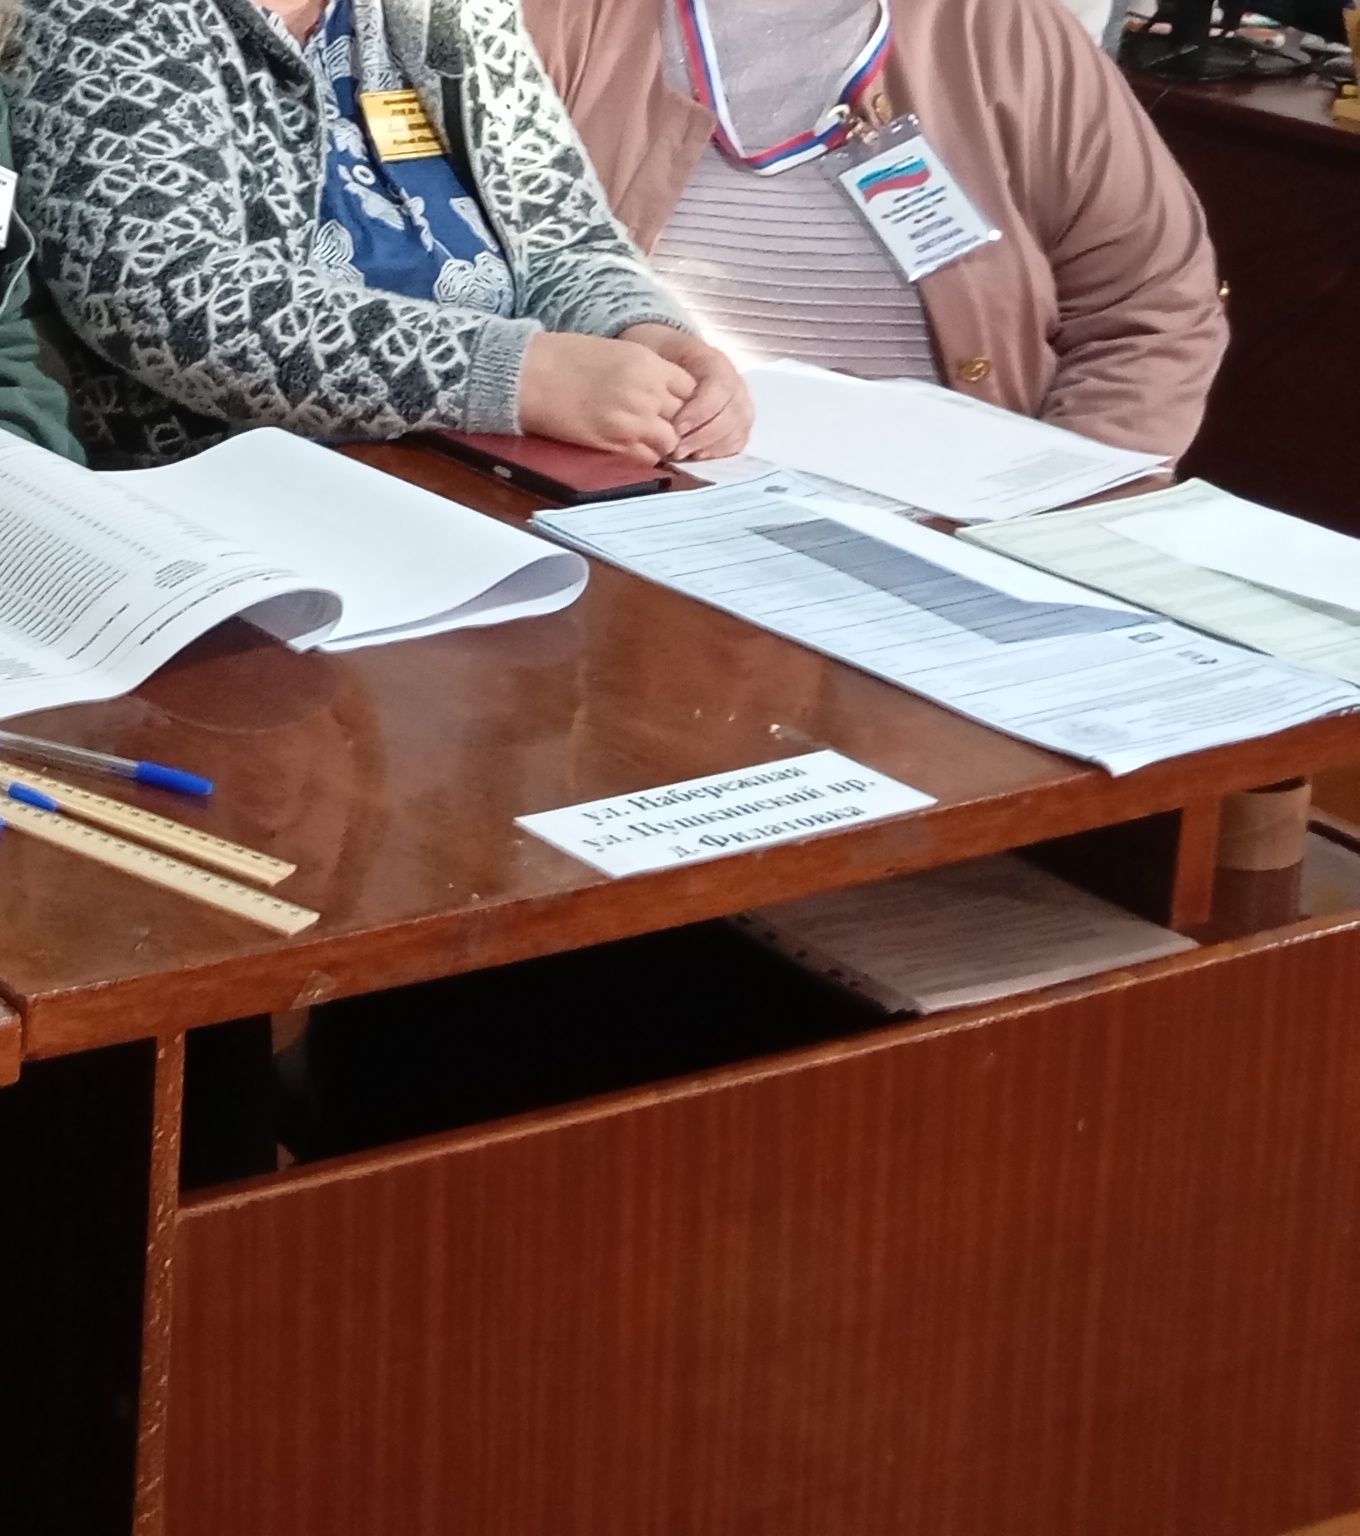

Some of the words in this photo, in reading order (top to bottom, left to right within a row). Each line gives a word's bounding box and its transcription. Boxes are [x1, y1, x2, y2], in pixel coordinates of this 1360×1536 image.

[581, 806, 630, 827] ул.
[629, 765, 807, 812] Набережная
[581, 832, 632, 853] ул.
[634, 788, 823, 839] Пушкинский
[827, 776, 876, 798] пр.
[698, 803, 867, 850] Филатовка
